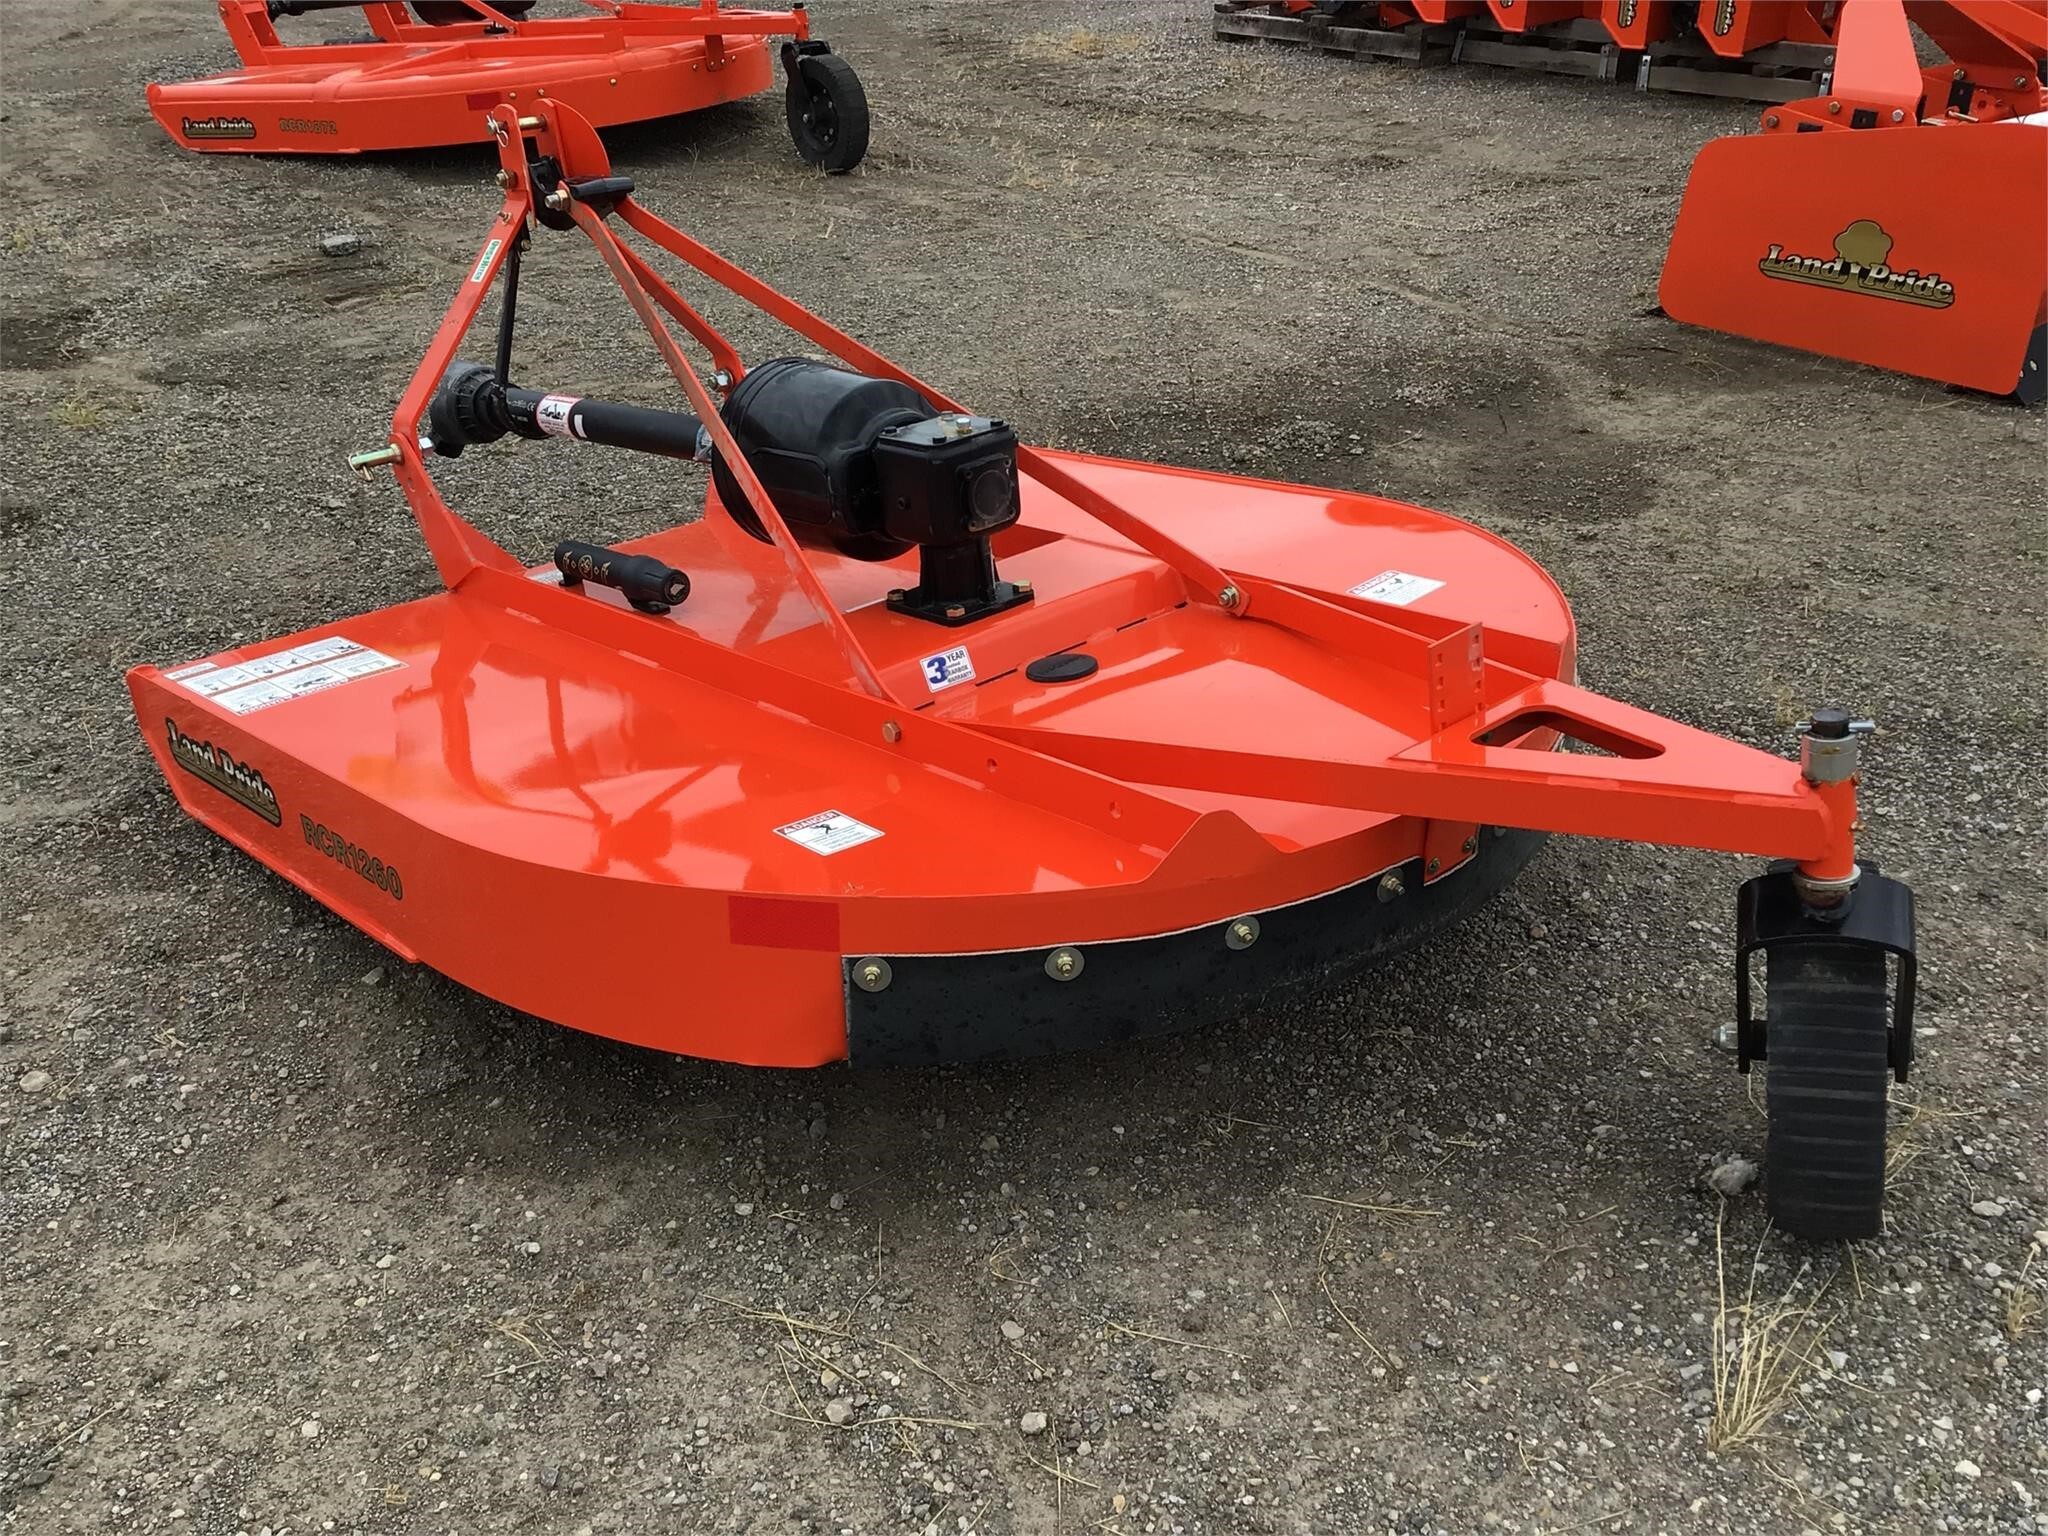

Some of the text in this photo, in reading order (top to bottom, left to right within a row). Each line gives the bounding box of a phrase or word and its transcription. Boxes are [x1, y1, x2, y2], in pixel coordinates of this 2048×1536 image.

[184, 117, 254, 136] Land Pride
[1763, 244, 1952, 299] Land Pride
[927, 657, 947, 684] 3
[946, 650, 965, 662] YEAR
[166, 719, 278, 814] Land Pride
[793, 812, 837, 829] DANGER
[300, 813, 403, 900] RCR1260
